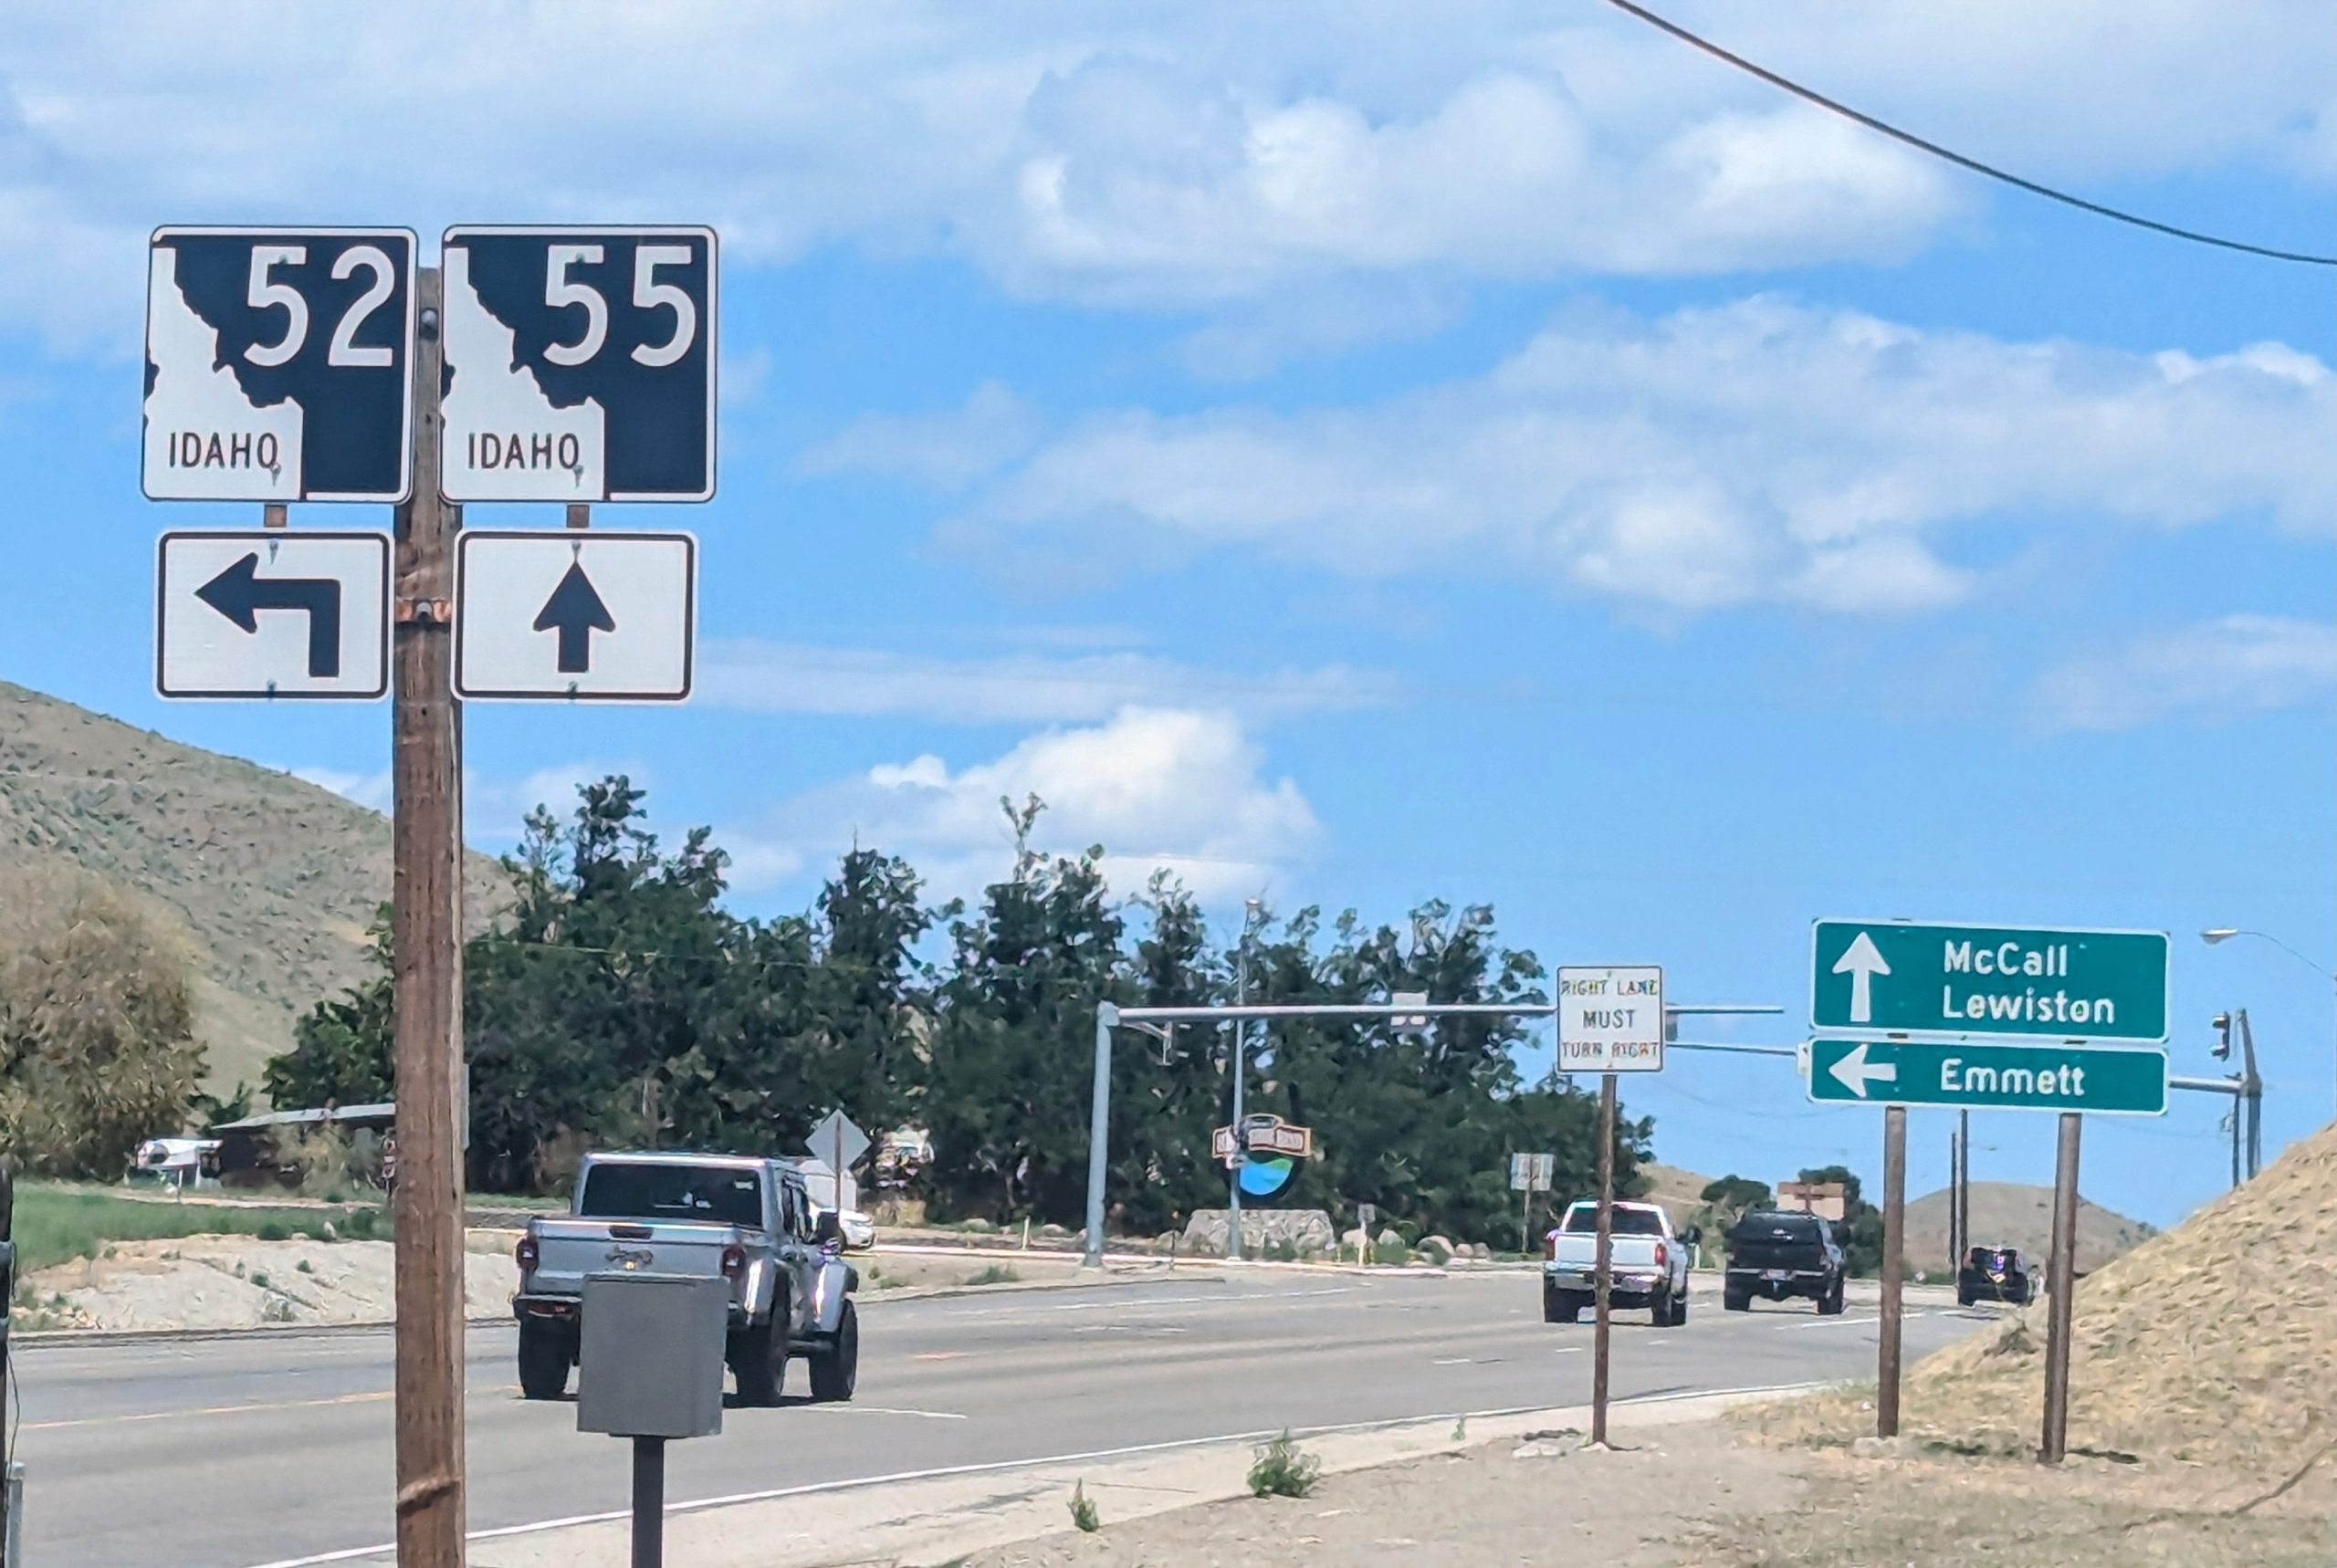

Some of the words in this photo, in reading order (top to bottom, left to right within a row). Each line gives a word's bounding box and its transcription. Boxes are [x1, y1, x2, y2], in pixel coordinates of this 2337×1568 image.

[244, 246, 395, 367] 52
[543, 245, 696, 366] 55
[169, 433, 279, 470] IDAHO
[467, 433, 580, 470] IDAHO
[1944, 940, 2068, 977] McCall
[1560, 979, 1608, 996] RIGHT
[1617, 979, 1658, 996] LANE
[1943, 985, 2115, 1024] Lewiston
[1583, 1009, 1635, 1029] MUST
[1562, 1042, 1602, 1058] TURN
[1611, 1042, 1659, 1058] RIGHT
[1940, 1059, 2085, 1096] Emmett
